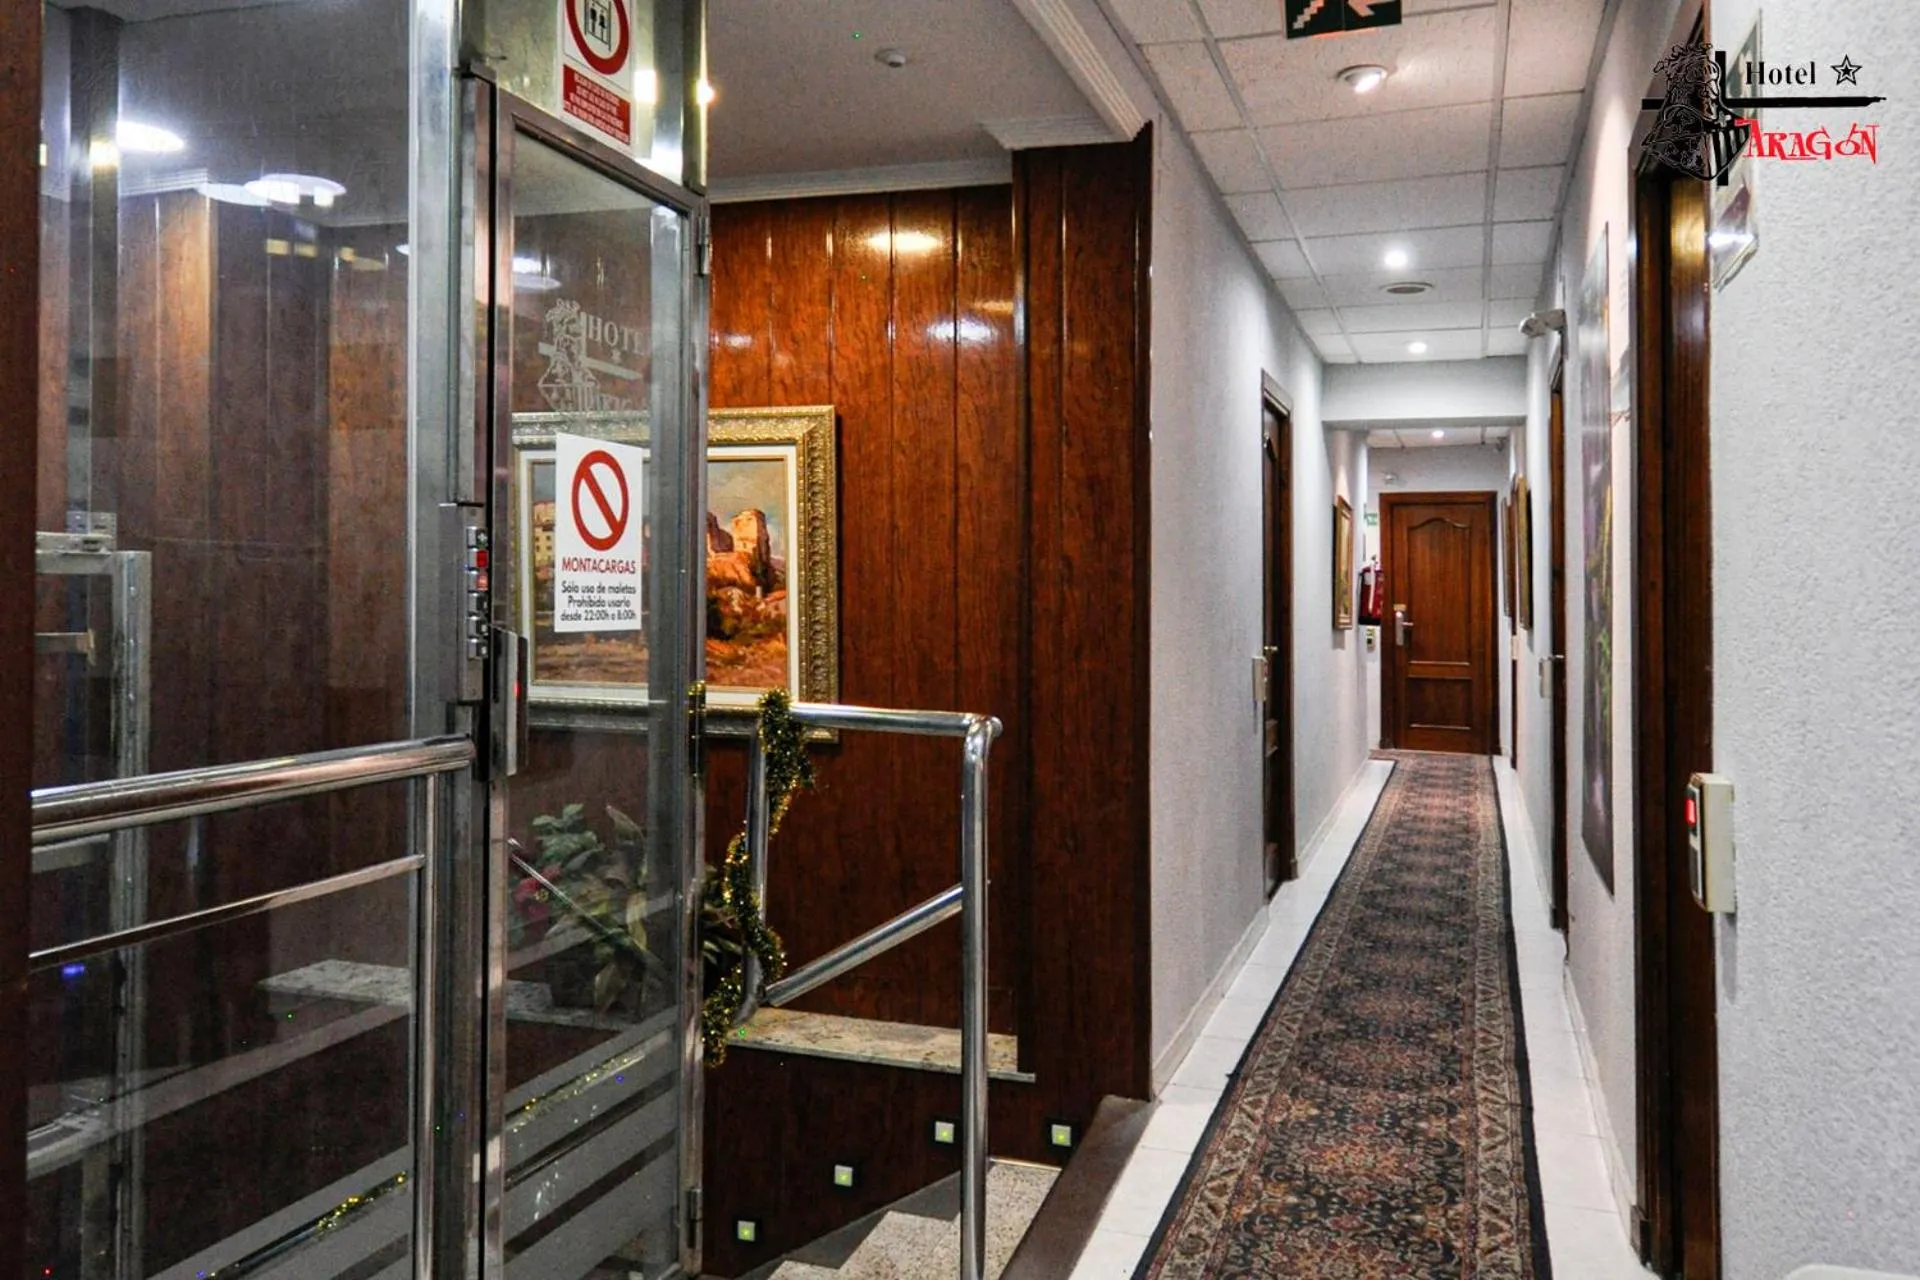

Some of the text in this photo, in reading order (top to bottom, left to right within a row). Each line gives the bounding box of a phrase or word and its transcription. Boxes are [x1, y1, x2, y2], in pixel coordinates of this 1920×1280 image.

[587, 313, 650, 356] HOTE
[562, 557, 636, 574] MONTACARGAS
[581, 585, 595, 594] uso
[596, 581, 606, 594] de
[608, 583, 637, 595] maletas
[567, 595, 606, 608] Prohibido
[560, 609, 582, 621] desde
